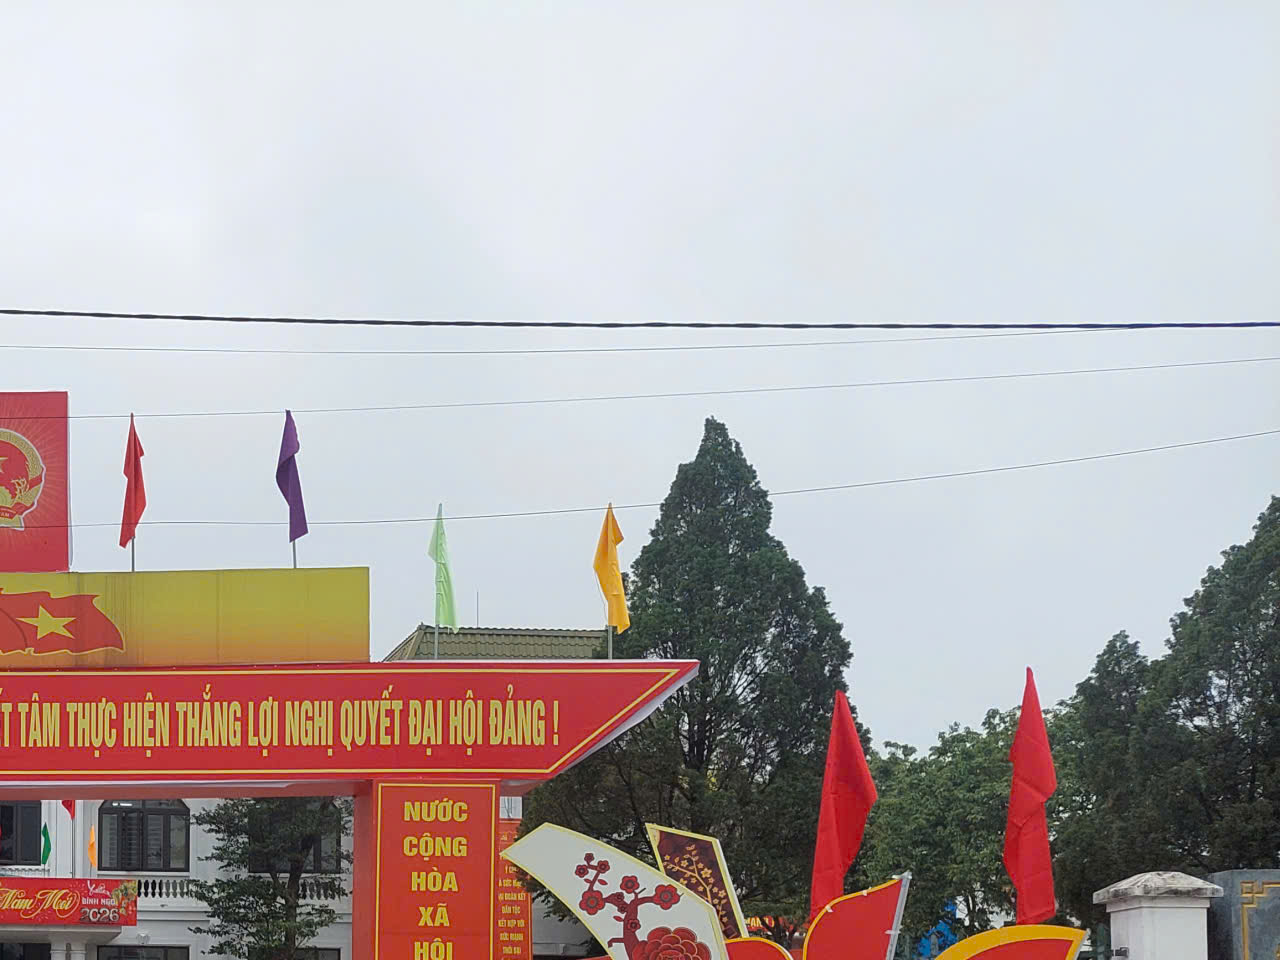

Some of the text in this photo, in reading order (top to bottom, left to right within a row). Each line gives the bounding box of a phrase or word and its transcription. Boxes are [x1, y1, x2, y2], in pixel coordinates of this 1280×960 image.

[17, 692, 60, 747] TÂM
[66, 697, 117, 758] THỰC
[123, 692, 170, 758] HIỆN
[175, 684, 242, 747] THẮNG
[248, 696, 279, 757] LỢI
[285, 700, 334, 757] NGHỊ
[340, 685, 403, 751] QUYẾT
[408, 700, 442, 756] ĐẠI
[449, 689, 483, 756] HỘI
[489, 684, 545, 746] ĐẢNG
[403, 798, 468, 822] NƯỚC
[403, 832, 468, 861] CỘNG
[411, 867, 458, 892] HÒA
[21, 888, 80, 918] Mới
[80, 907, 119, 921] 2026
[418, 903, 450, 927] XÃ
